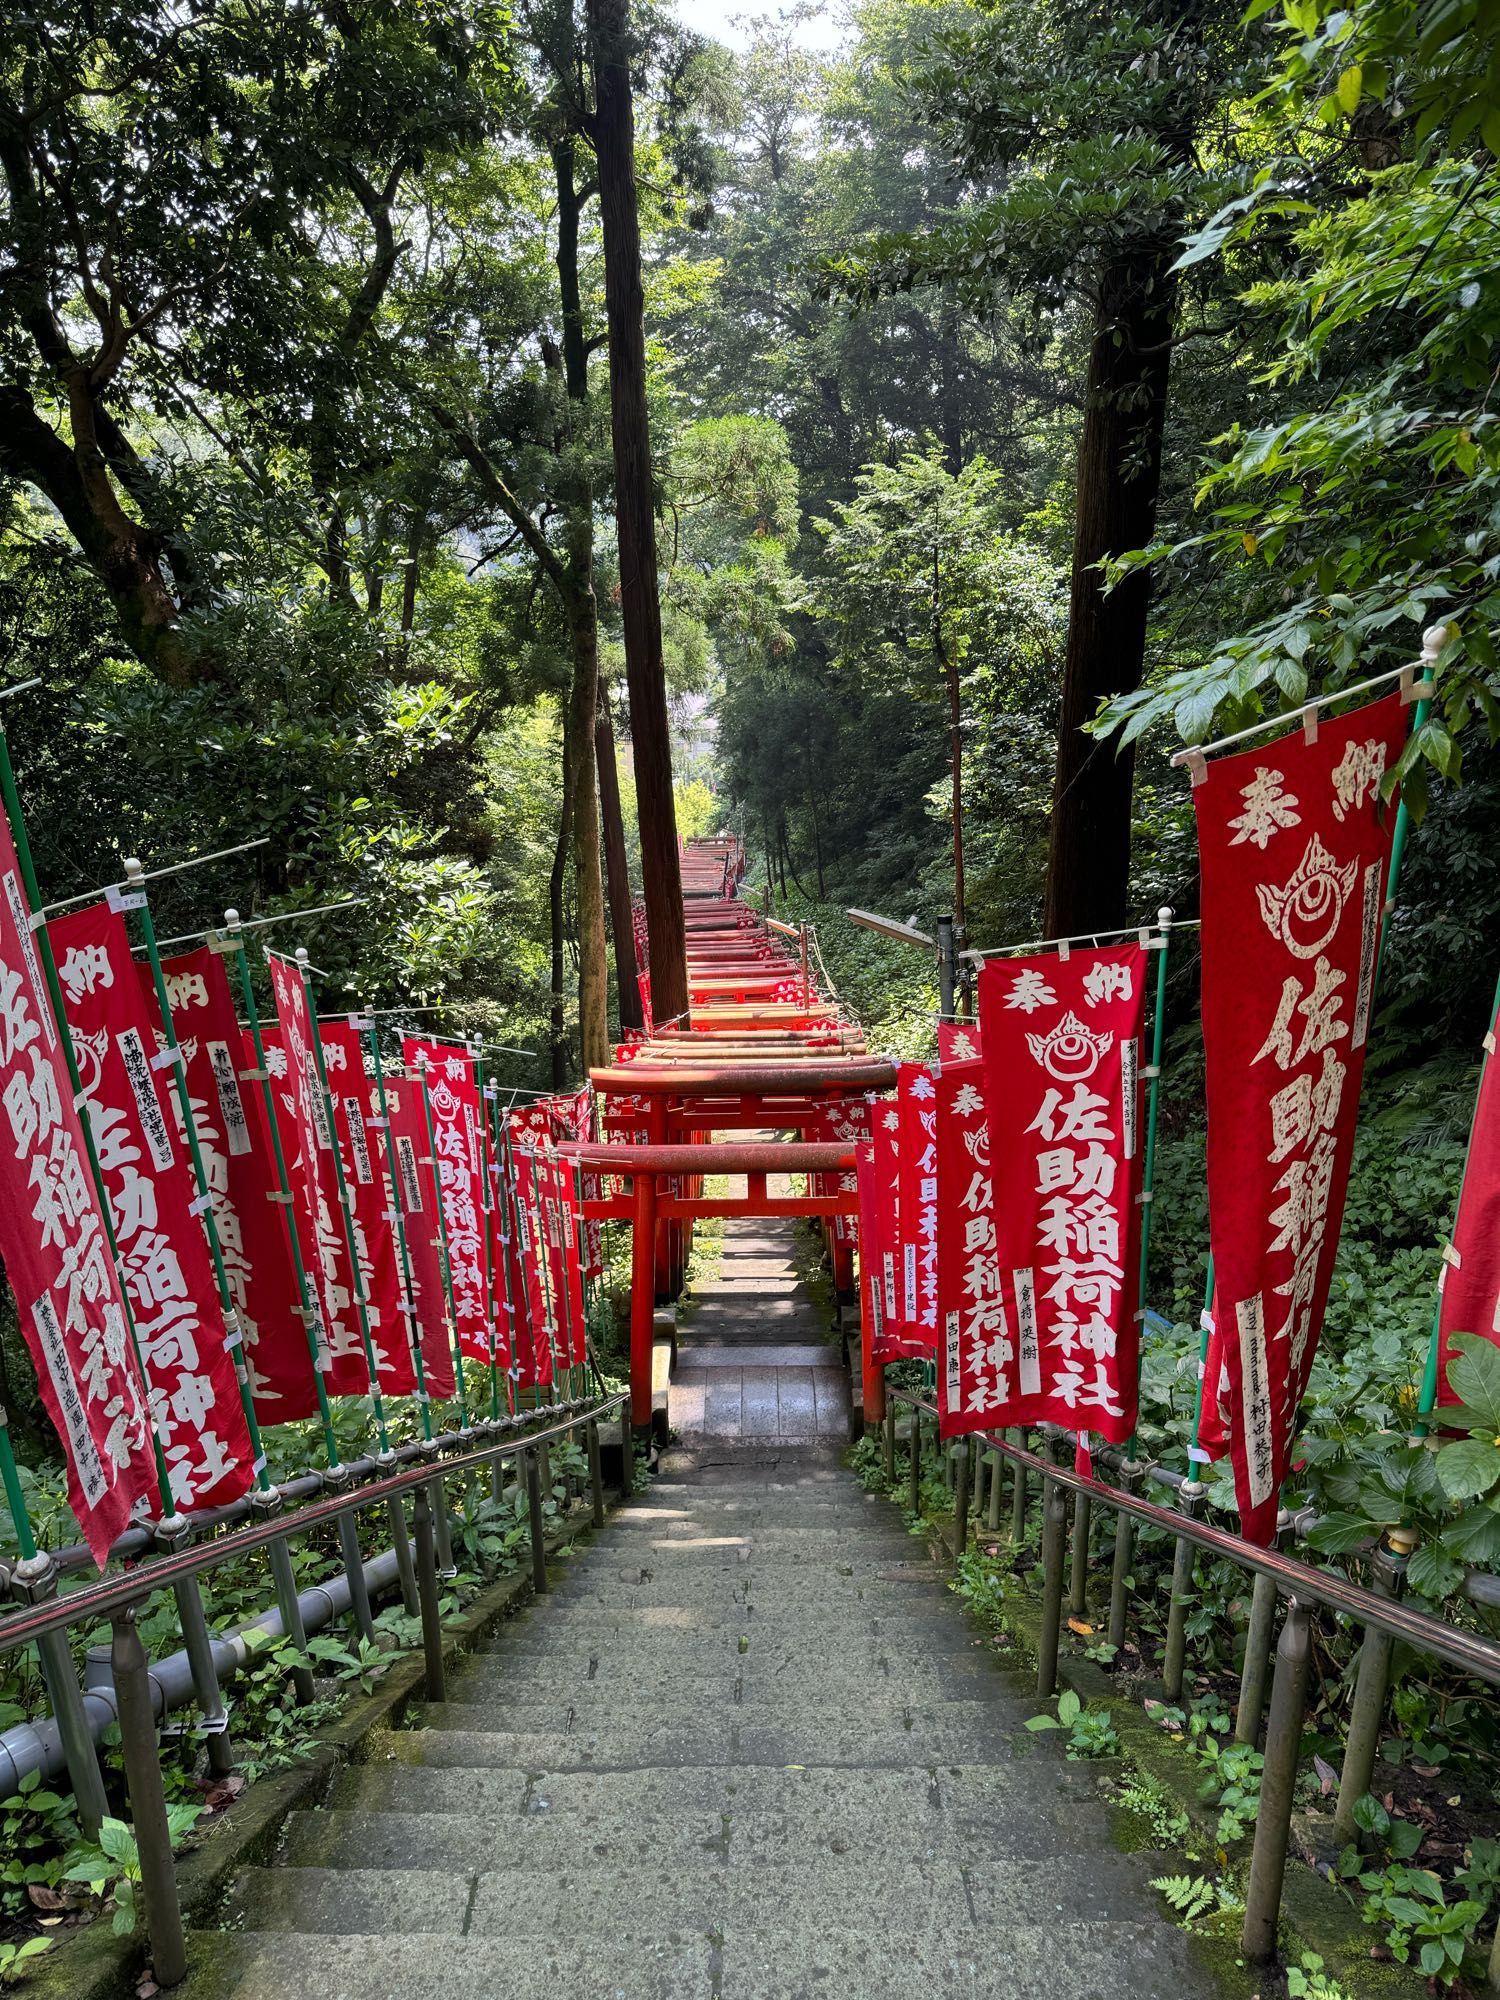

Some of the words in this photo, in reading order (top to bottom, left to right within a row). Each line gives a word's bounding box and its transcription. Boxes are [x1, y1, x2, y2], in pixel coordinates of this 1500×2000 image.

[1226, 738, 1388, 848] 奉納
[59, 944, 114, 1005] 納
[153, 973, 209, 1012] 納
[1003, 962, 1133, 1014] 奉納
[413, 1047, 466, 1082] 奉納
[949, 1031, 977, 1059] 奉
[908, 1075, 935, 1100] 奉
[950, 1083, 984, 1118] 奉
[434, 1121, 485, 1320] 佐助稲荷神社
[1024, 1082, 1125, 1418] 佐助稲荷神社
[1246, 1311, 1257, 1331] my
